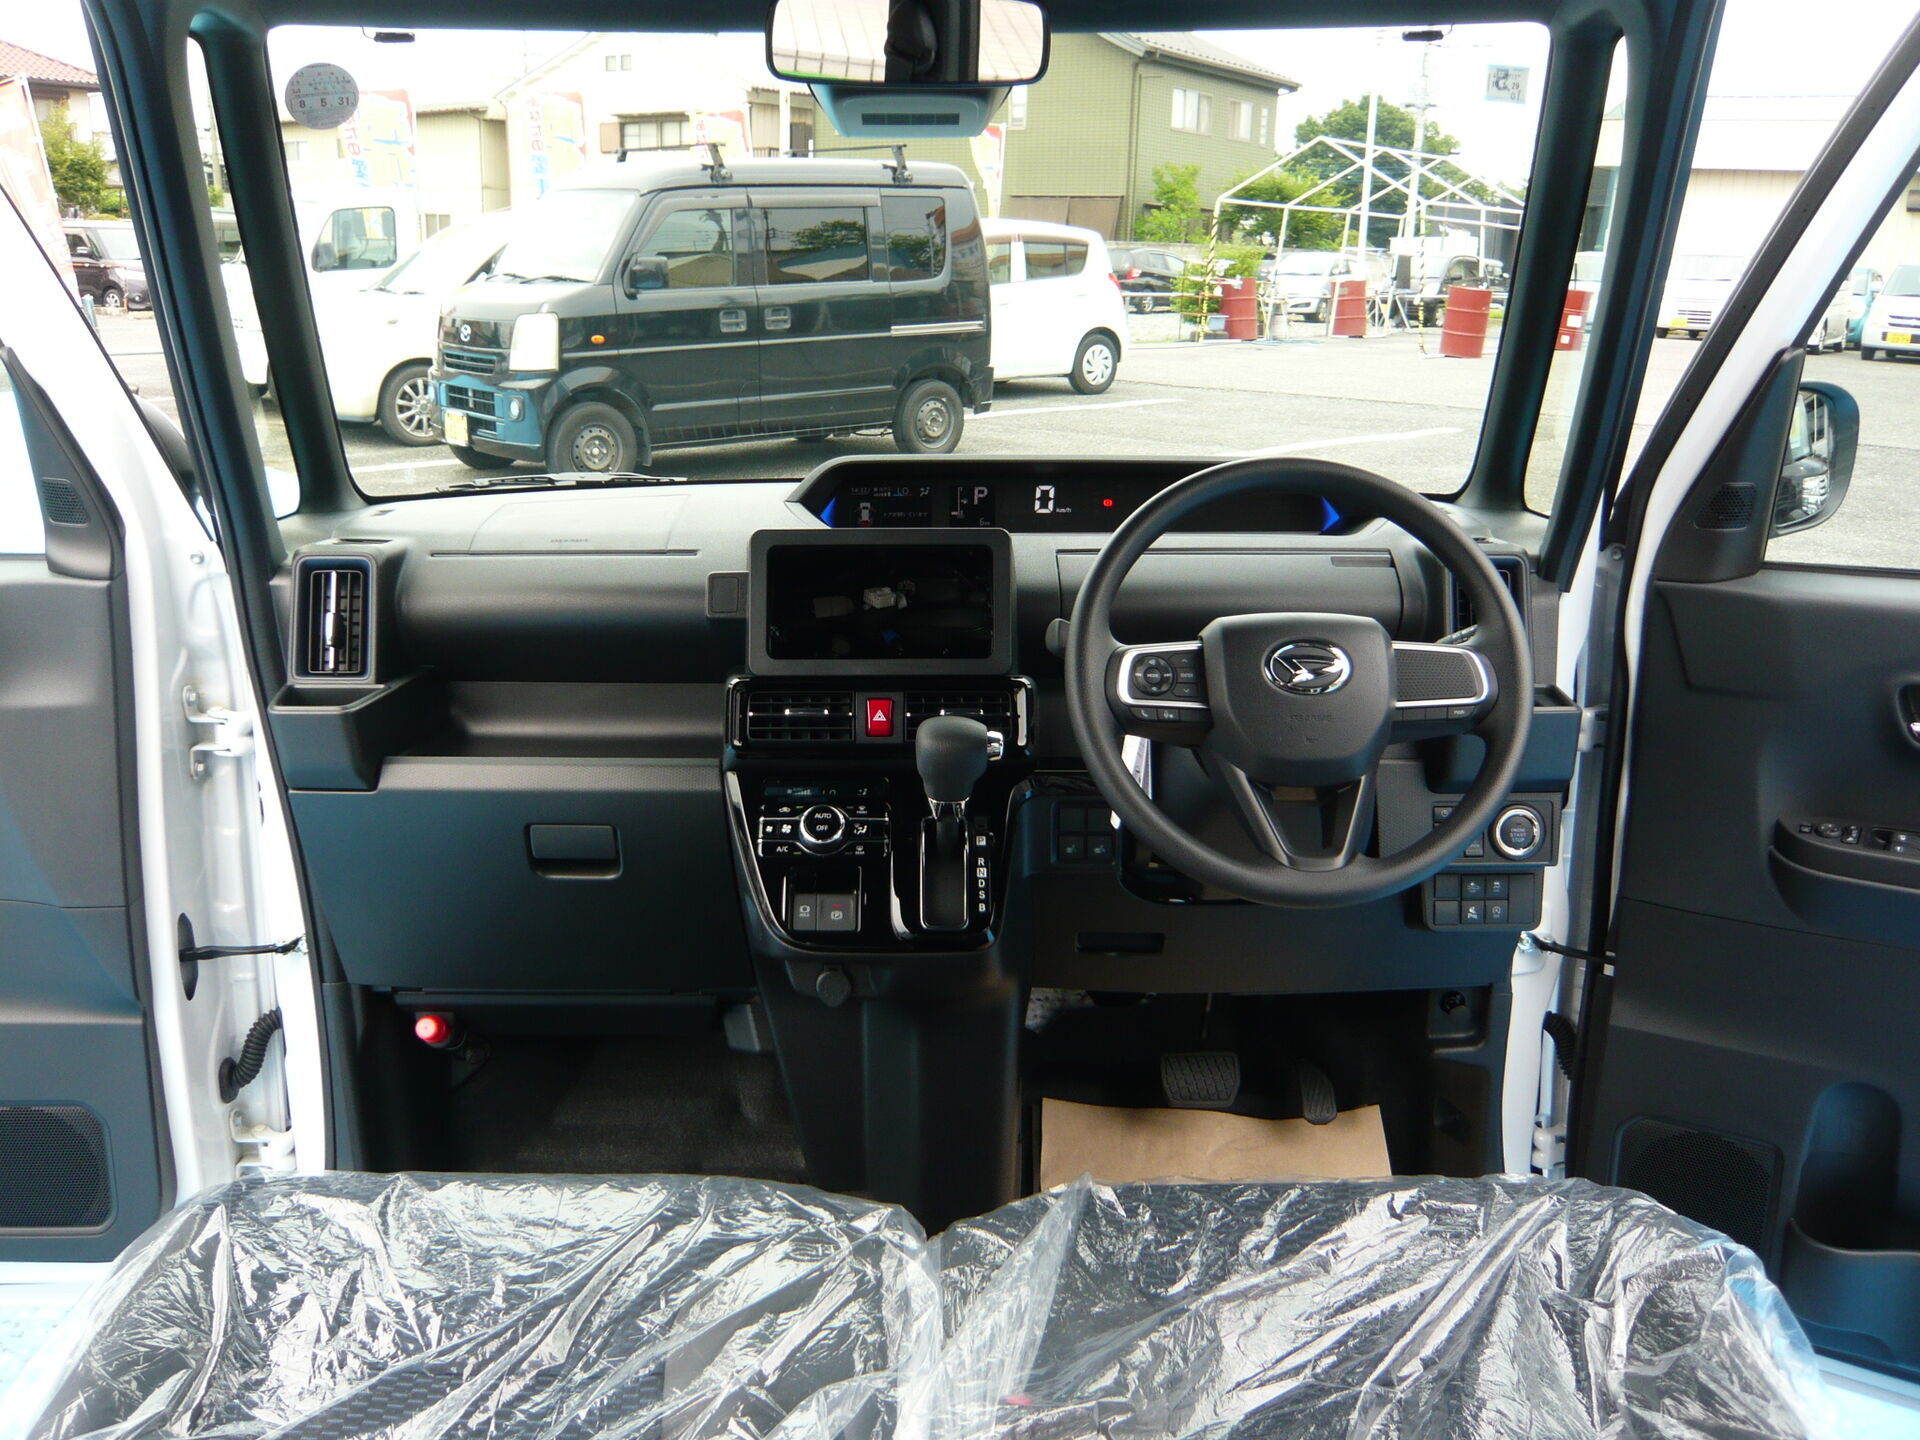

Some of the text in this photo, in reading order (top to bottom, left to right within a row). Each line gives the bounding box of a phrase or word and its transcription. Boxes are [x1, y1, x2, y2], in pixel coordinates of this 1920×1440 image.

[973, 486, 988, 505] P
[1034, 485, 1055, 514] 0
[977, 857, 985, 866] R
[978, 879, 985, 888] D
[978, 890, 986, 899] S
[978, 903, 986, 912] B
